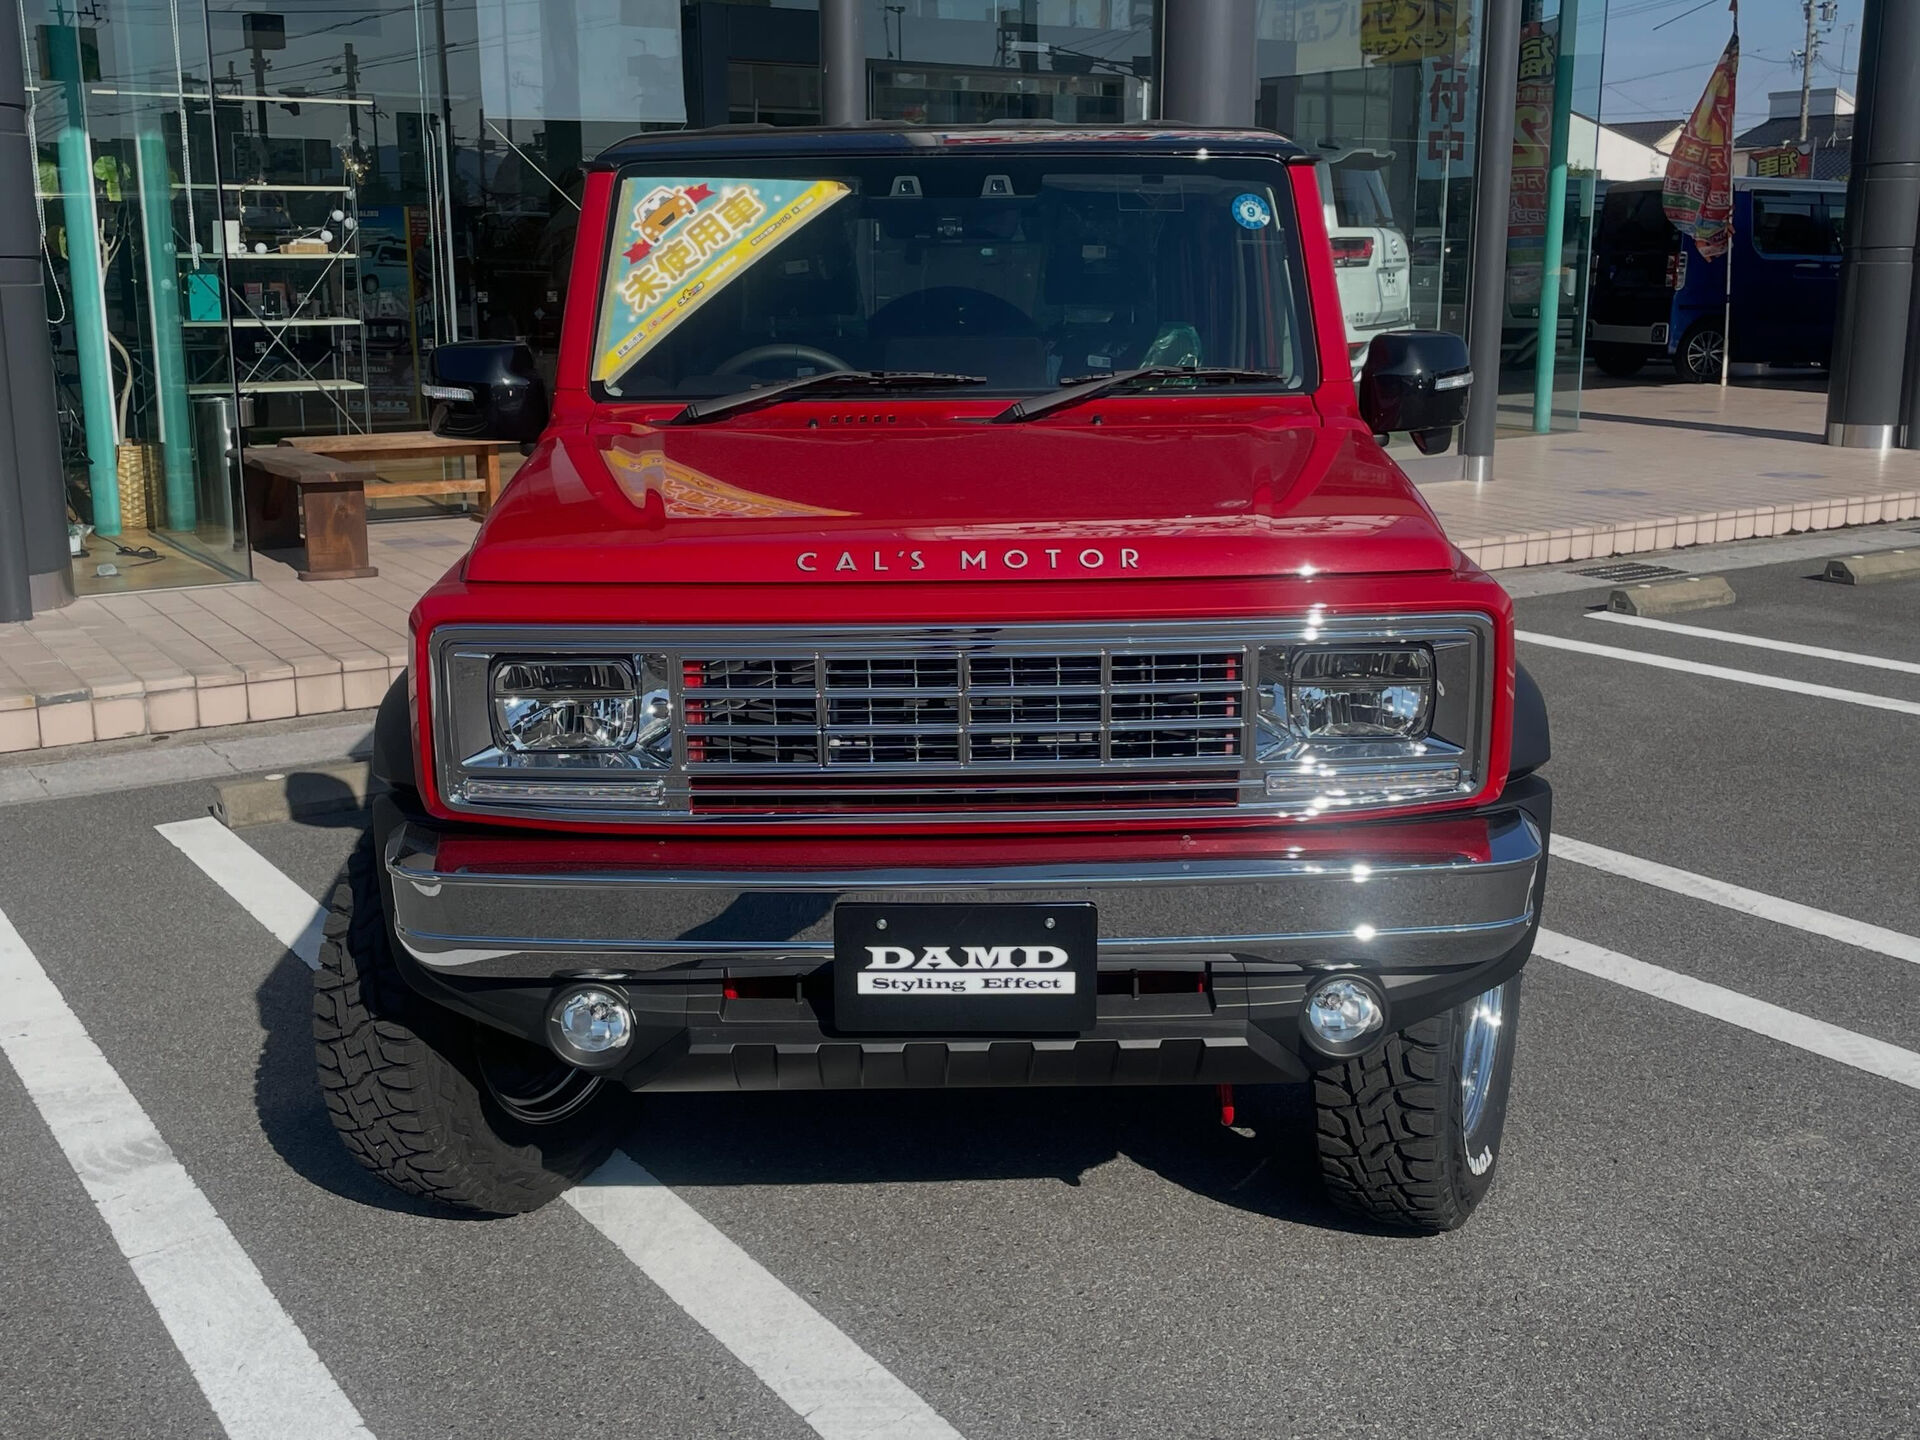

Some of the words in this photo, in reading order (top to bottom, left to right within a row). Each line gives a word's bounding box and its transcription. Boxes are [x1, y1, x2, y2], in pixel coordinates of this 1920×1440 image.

[623, 187, 763, 311] 未使用車
[796, 550, 925, 572] CAL'S
[960, 548, 1140, 571] MOTOR
[864, 945, 1069, 970] DAMD
[872, 977, 966, 992] Styling
[982, 977, 1061, 989] Effect
